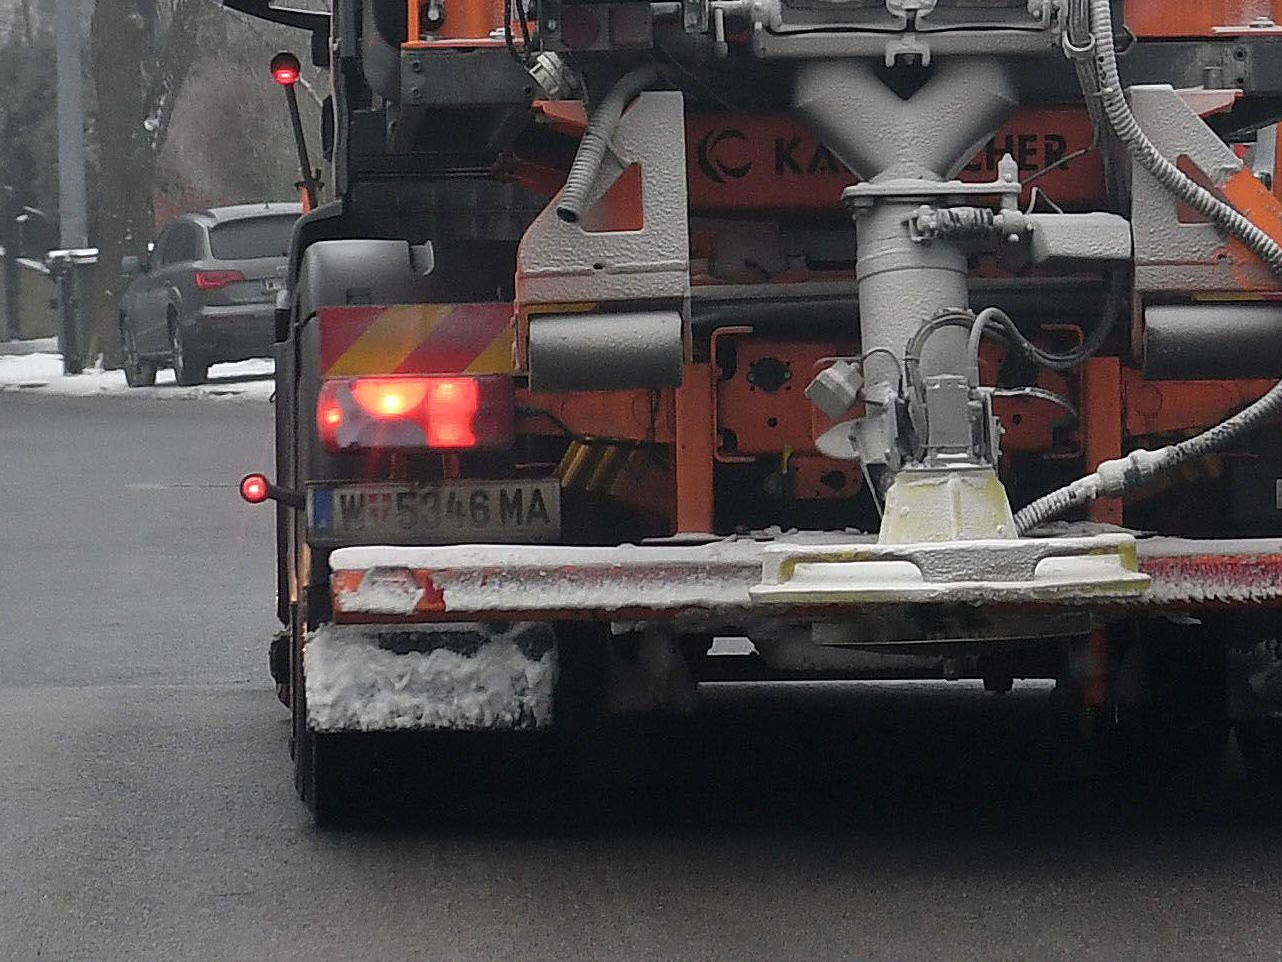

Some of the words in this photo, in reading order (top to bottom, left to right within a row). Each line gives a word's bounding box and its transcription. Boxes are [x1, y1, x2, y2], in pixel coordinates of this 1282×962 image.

[339, 493, 364, 531] W
[395, 489, 491, 530] 5346
[499, 487, 551, 526] MA
